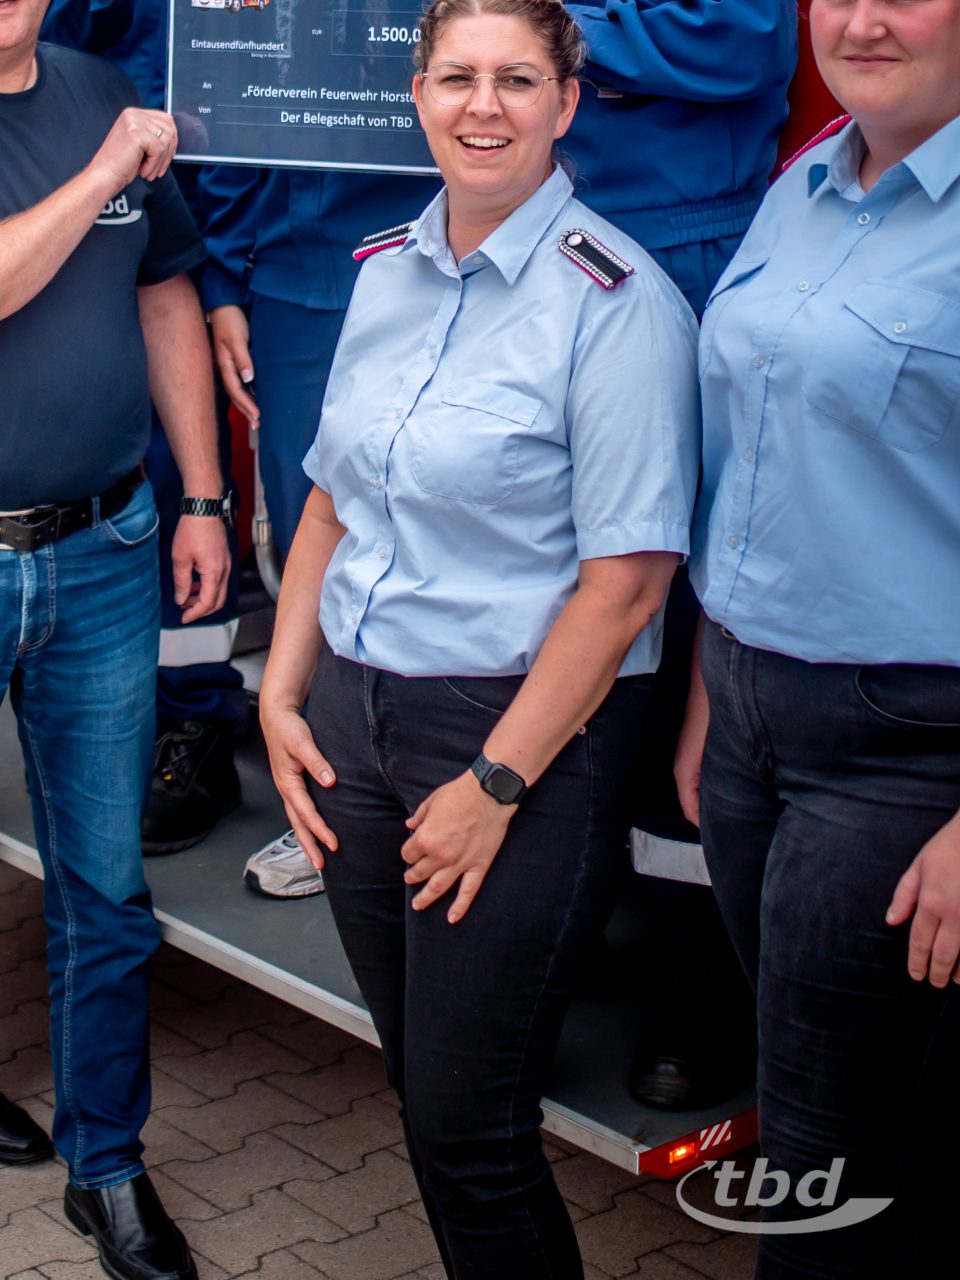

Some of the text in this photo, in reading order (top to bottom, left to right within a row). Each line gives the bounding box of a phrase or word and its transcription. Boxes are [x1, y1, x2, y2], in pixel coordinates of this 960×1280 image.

[367, 26, 421, 45] 1.500,0
[191, 39, 285, 51] Eintausendfünfhundert
[202, 81, 212, 89] An
[242, 85, 416, 103] „Förderverein Feuerwehr Horste
[198, 106, 211, 114] Von
[280, 111, 413, 128] Der Belegschaft von TBD
[100, 194, 129, 214] bd
